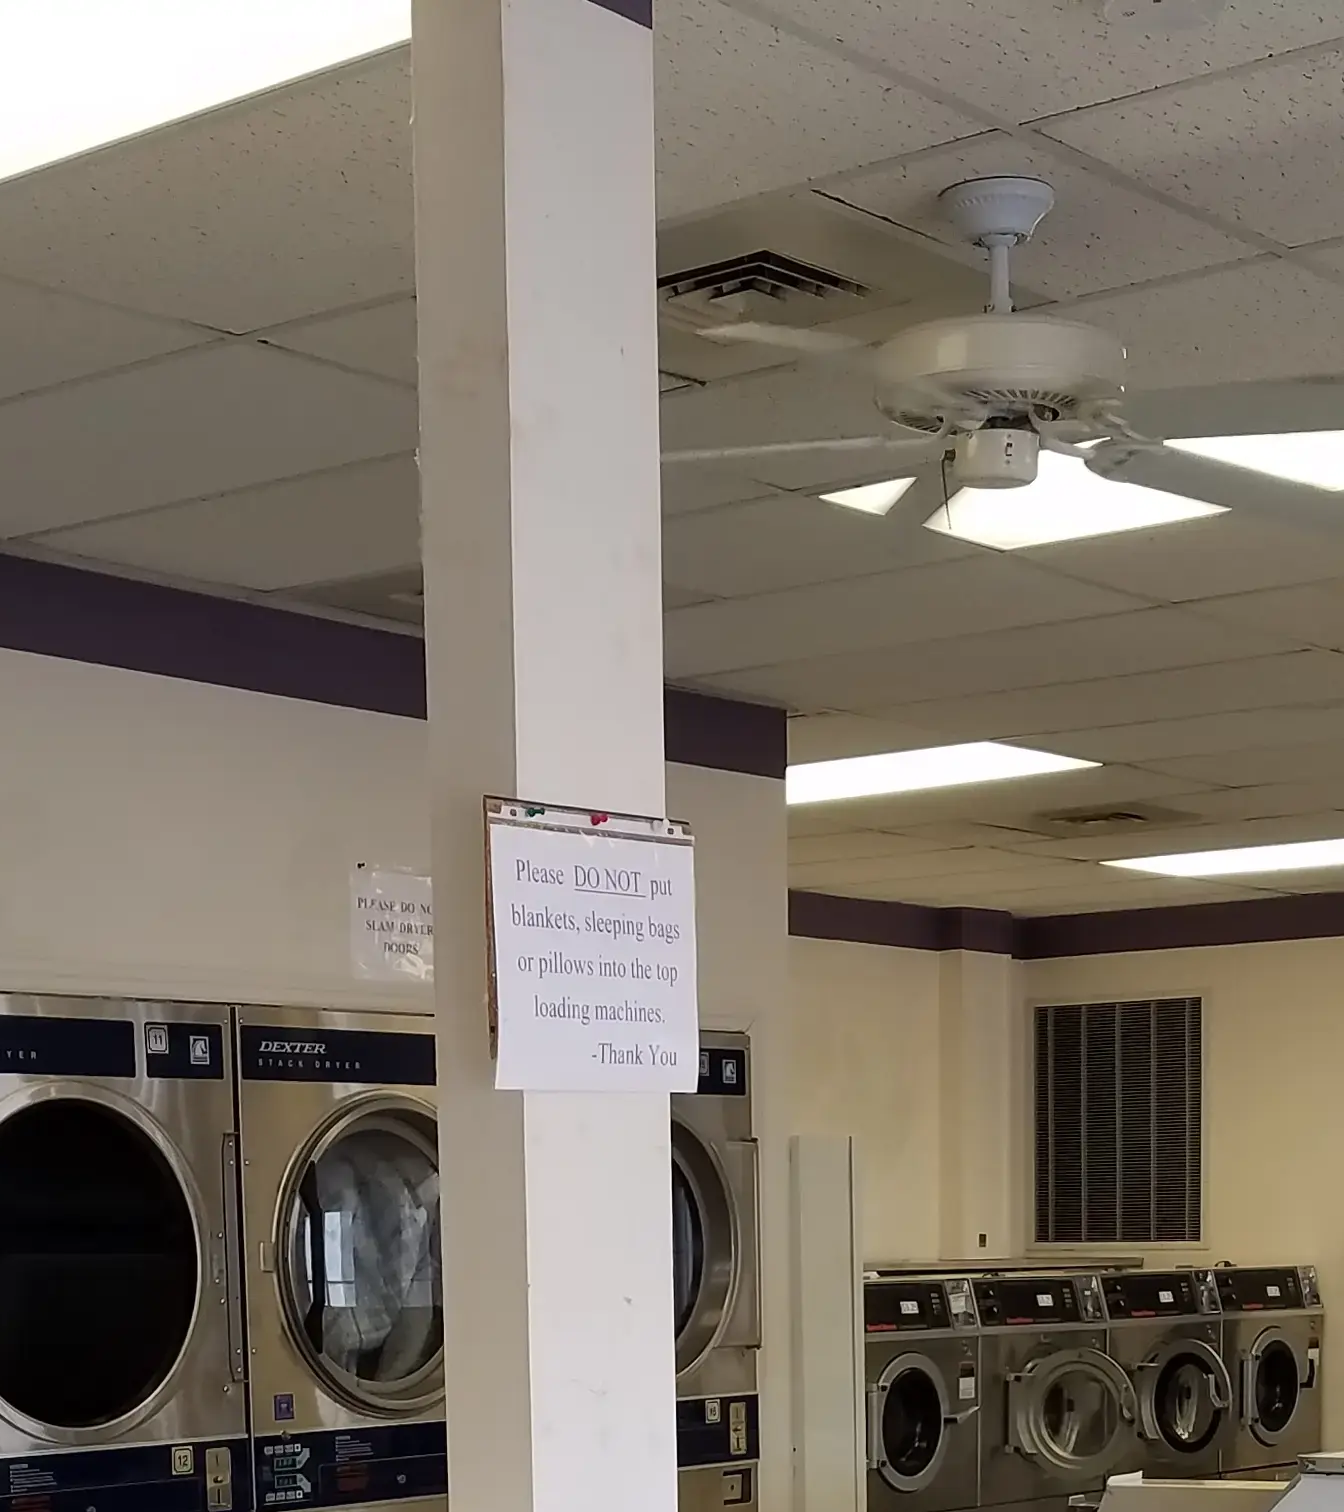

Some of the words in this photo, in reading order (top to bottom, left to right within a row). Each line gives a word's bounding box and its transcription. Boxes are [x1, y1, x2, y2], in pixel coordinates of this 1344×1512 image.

[516, 859, 564, 886] Please
[574, 865, 600, 889] DO
[605, 868, 641, 893] NOT
[650, 878, 672, 900] put
[357, 897, 395, 911] PLEASE
[401, 902, 415, 913] DO
[366, 920, 394, 932] SLAM
[512, 904, 580, 933] blankets,
[585, 911, 644, 941] sleeping
[649, 916, 679, 944] bags
[518, 955, 534, 972] or
[539, 951, 593, 978] pillows
[599, 955, 626, 978] into
[631, 957, 651, 979] the
[657, 960, 678, 986] top
[535, 995, 590, 1025] loading
[595, 1000, 665, 1024] machines.
[259, 1041, 327, 1054] DEXTER
[592, 1042, 643, 1066] -Thank
[649, 1045, 677, 1067] You
[177, 1455, 188, 1466] 12
